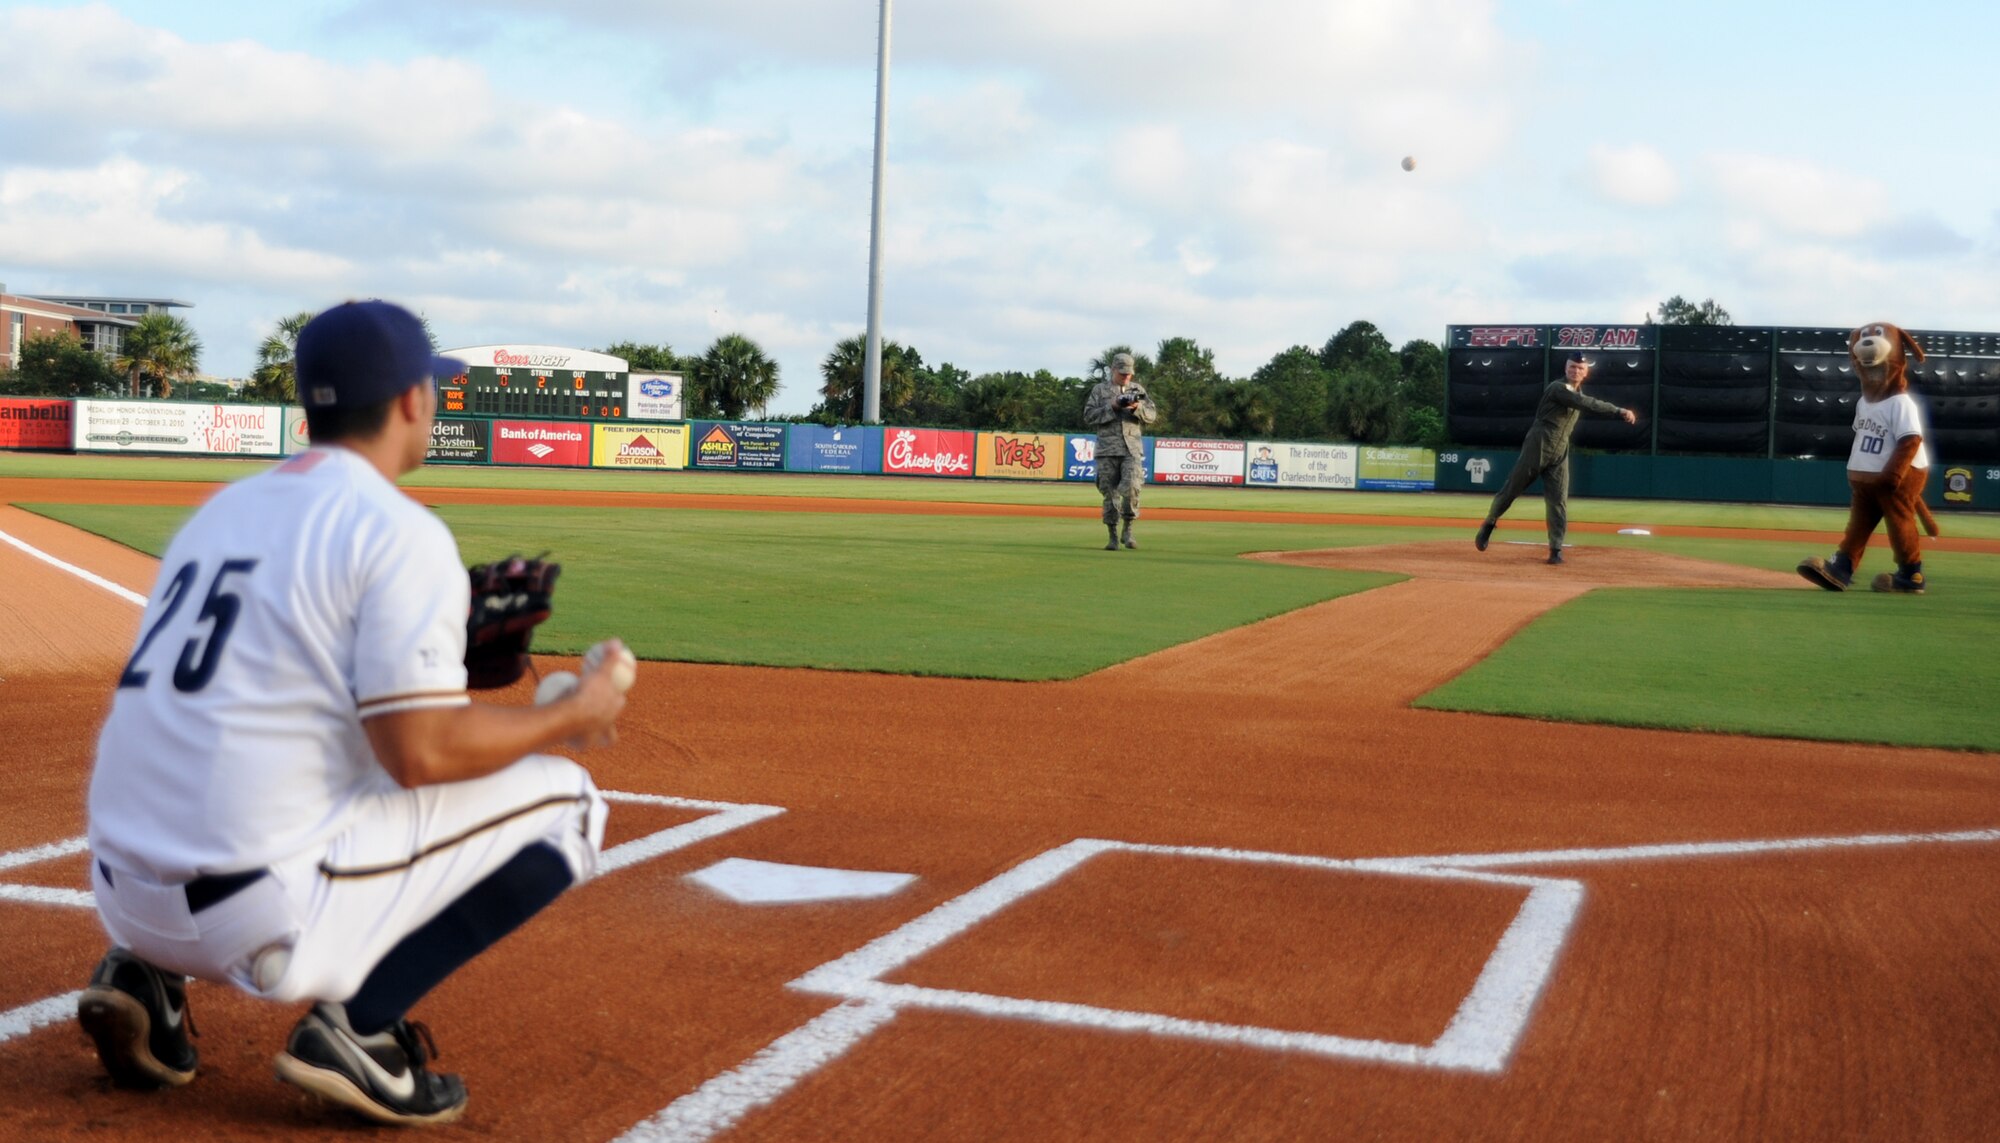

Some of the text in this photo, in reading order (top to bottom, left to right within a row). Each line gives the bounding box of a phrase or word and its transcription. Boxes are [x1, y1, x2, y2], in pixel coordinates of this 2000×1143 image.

[1471, 327, 1639, 347] ESPN 910 AM
[494, 349, 570, 367] Coors LIGHT
[496, 368, 512, 376] BALL
[530, 369, 554, 377] STRIKE
[572, 371, 587, 379] OUT
[538, 376, 546, 388] 2
[575, 378, 583, 390] 0
[447, 391, 465, 400] ROME
[0, 404, 69, 420] ambelli
[213, 404, 265, 430] Beyond
[501, 427, 582, 441] Bank of America
[625, 426, 681, 435] INSPECTIONS
[204, 427, 240, 453] Valor
[440, 436, 476, 448] System
[1156, 440, 1244, 450] FACTORY CONNECTION?
[1860, 435, 1884, 455] 00
[621, 443, 658, 456] DODSON
[701, 442, 734, 453] ASHLEY
[887, 436, 969, 473] Chick-fil-A
[1190, 453, 1210, 461] KIA
[1290, 447, 1348, 460] The Favorite Grits
[1440, 453, 1458, 463] 398
[615, 457, 667, 466] PEST CONTROL
[1180, 463, 1219, 471] COUNTRY
[1308, 461, 1328, 471] of the
[1182, 474, 1233, 483] COMMENT!
[1251, 468, 1276, 480] GRITS
[1281, 471, 1317, 482] Charleston
[1986, 469, 2000, 480] 39
[118, 558, 260, 693] 25
